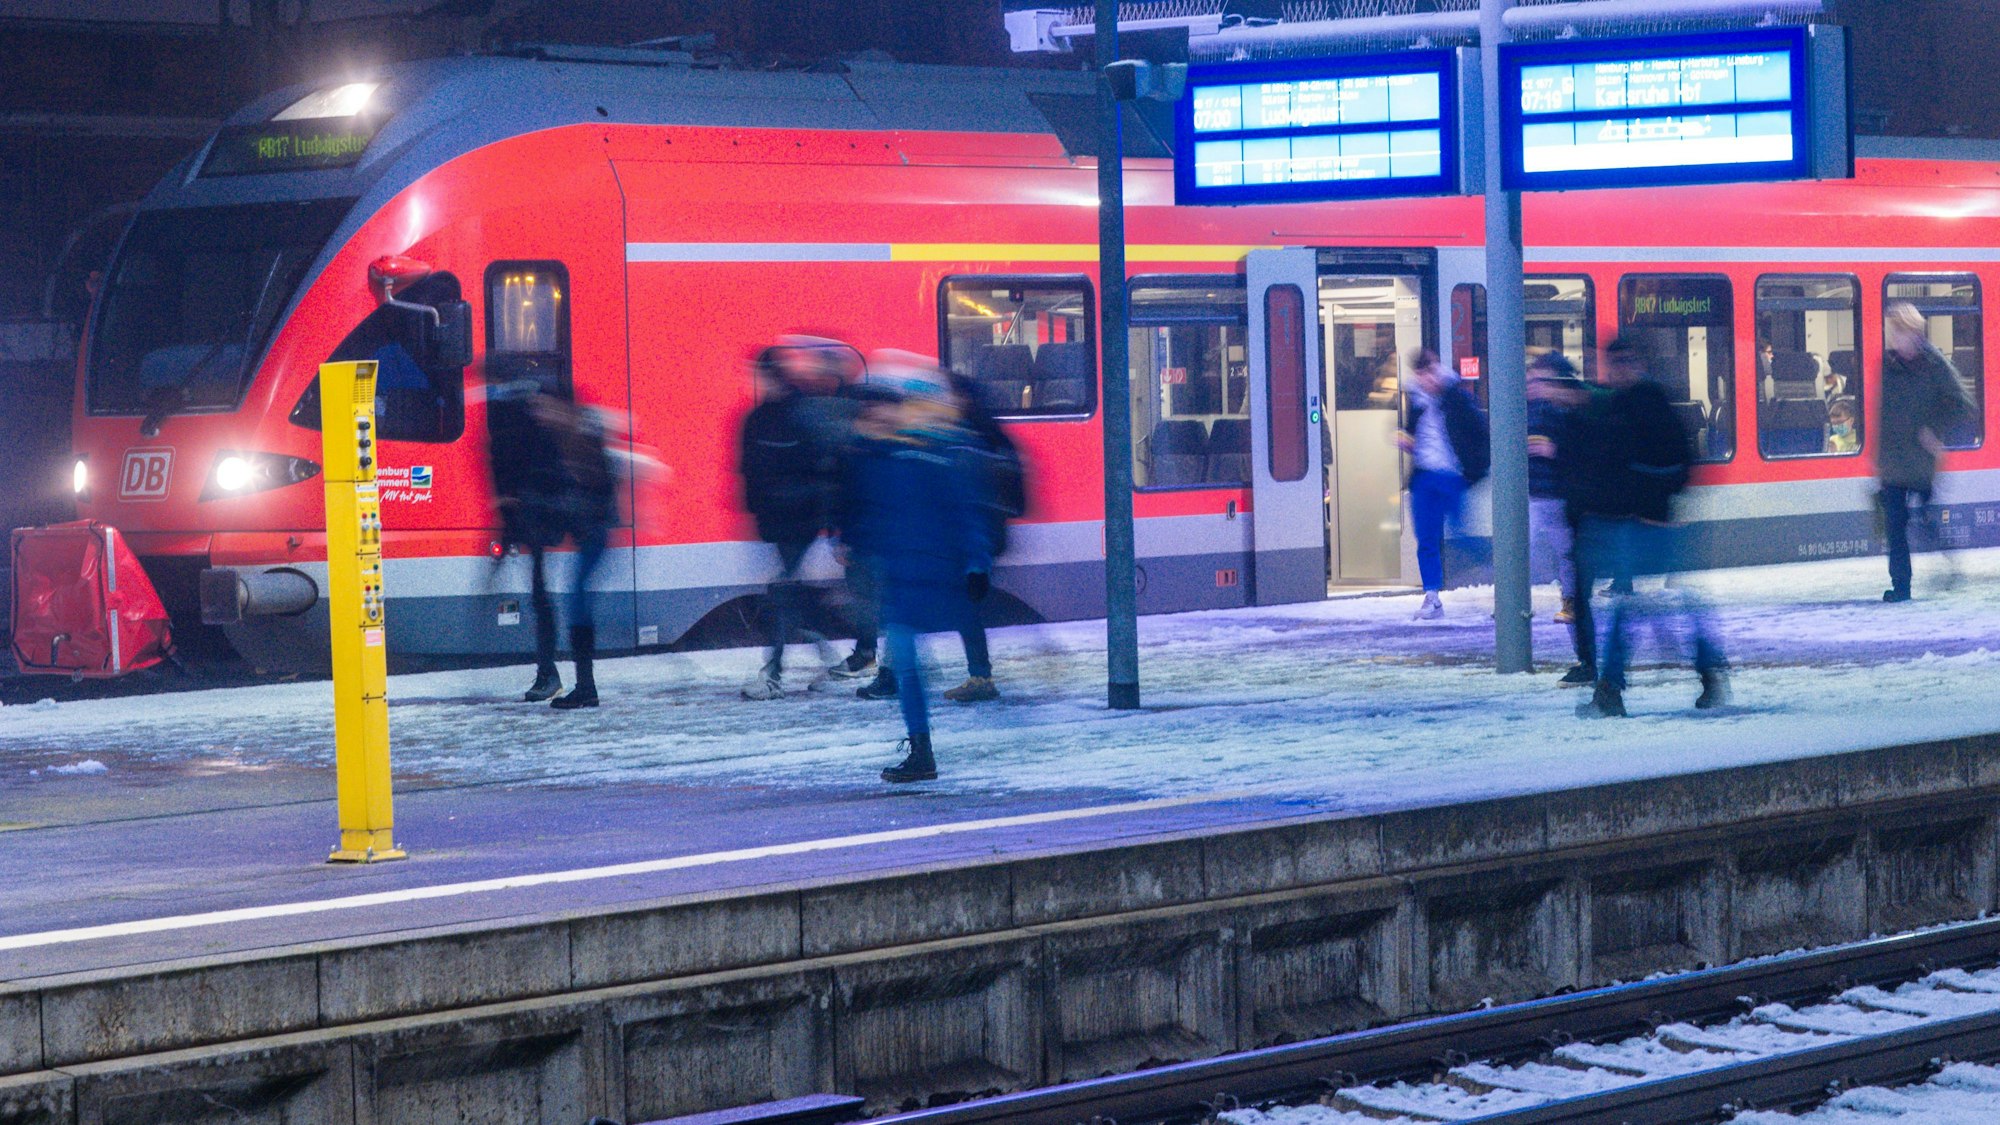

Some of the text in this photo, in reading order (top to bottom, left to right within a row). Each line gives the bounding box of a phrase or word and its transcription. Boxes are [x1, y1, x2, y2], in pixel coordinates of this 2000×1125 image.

[1522, 90, 1562, 111] 07:19
[1596, 82, 1701, 107] Karlsruhe Hbf
[1261, 104, 1345, 127] Ludwigslust
[295, 132, 370, 157] Ludwigslus
[1659, 296, 1711, 315] Ludwigslust
[124, 456, 166, 492] DB
[377, 466, 409, 477] enburg
[377, 478, 409, 487] mmern
